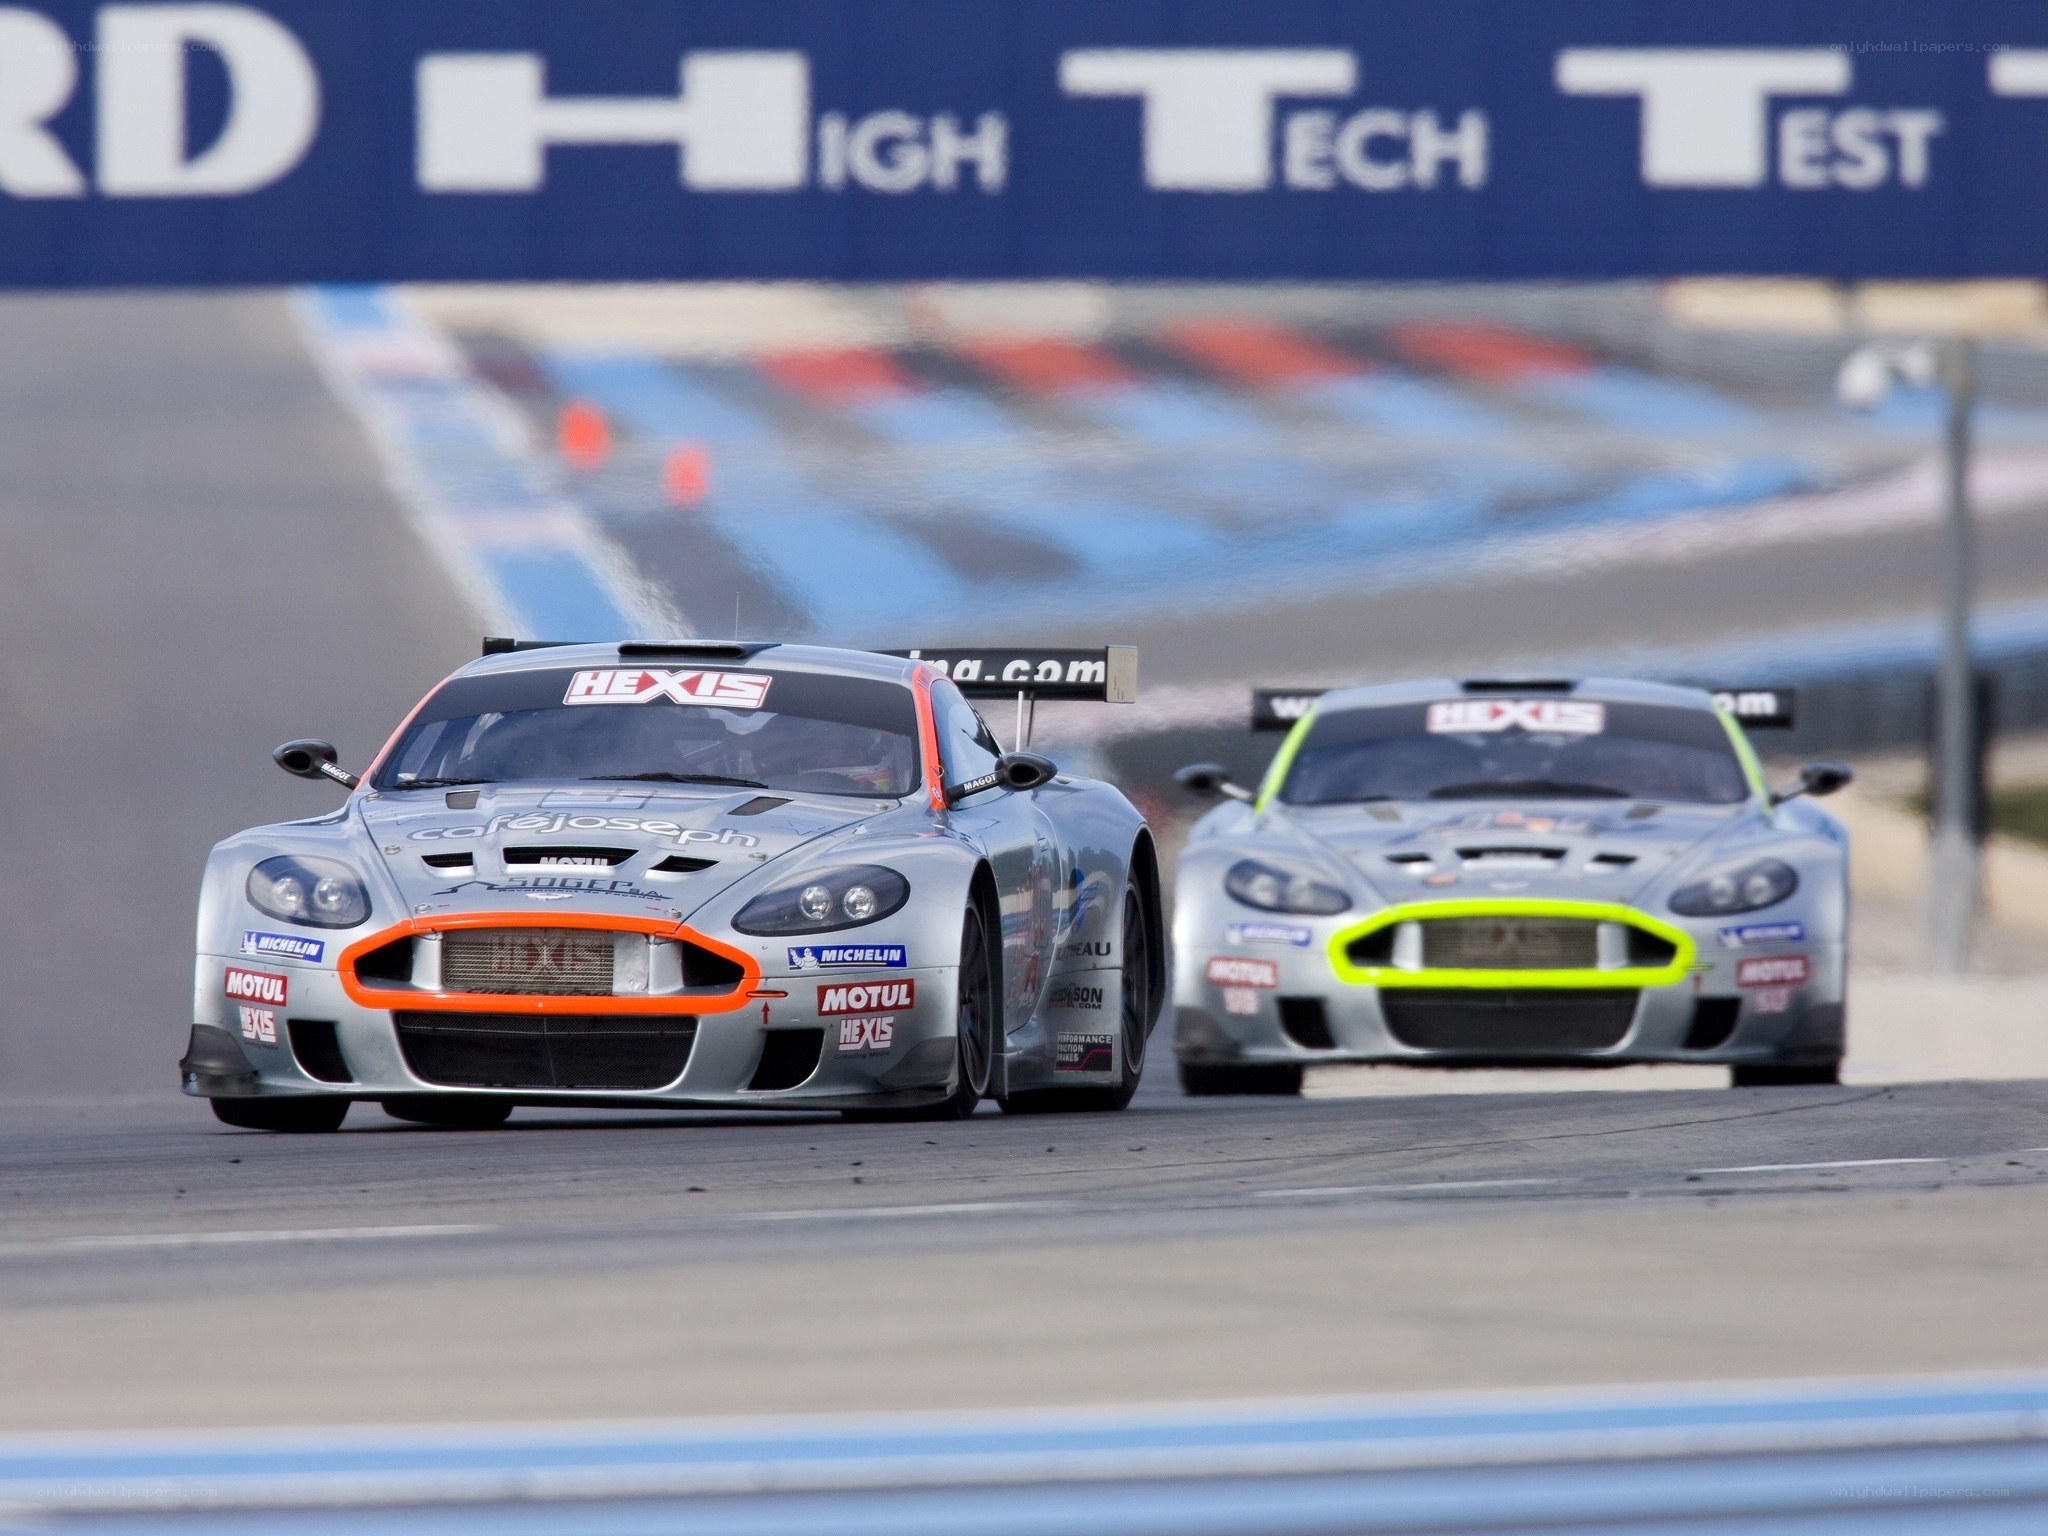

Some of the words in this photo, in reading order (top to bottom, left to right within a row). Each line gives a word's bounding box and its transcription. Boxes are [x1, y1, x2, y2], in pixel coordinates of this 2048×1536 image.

[414, 50, 1010, 194] HIGH
[1058, 48, 1489, 191] TECH
[1554, 47, 1944, 190] TEST
[565, 669, 772, 708] HEXIS
[1427, 702, 1605, 734] HEXIS
[321, 762, 352, 781] MAGOT
[963, 773, 998, 791] MAGOT
[408, 812, 760, 848] caféjoseph
[258, 936, 321, 956] MICHELIN
[821, 949, 901, 962] MICHELIN
[226, 971, 285, 1002] MOTUL
[821, 984, 911, 1012] MOTUL
[239, 1005, 277, 1043] HEXIS
[838, 1016, 895, 1051] HEXIS
[1058, 1034, 1112, 1044] PERFORMANCE
